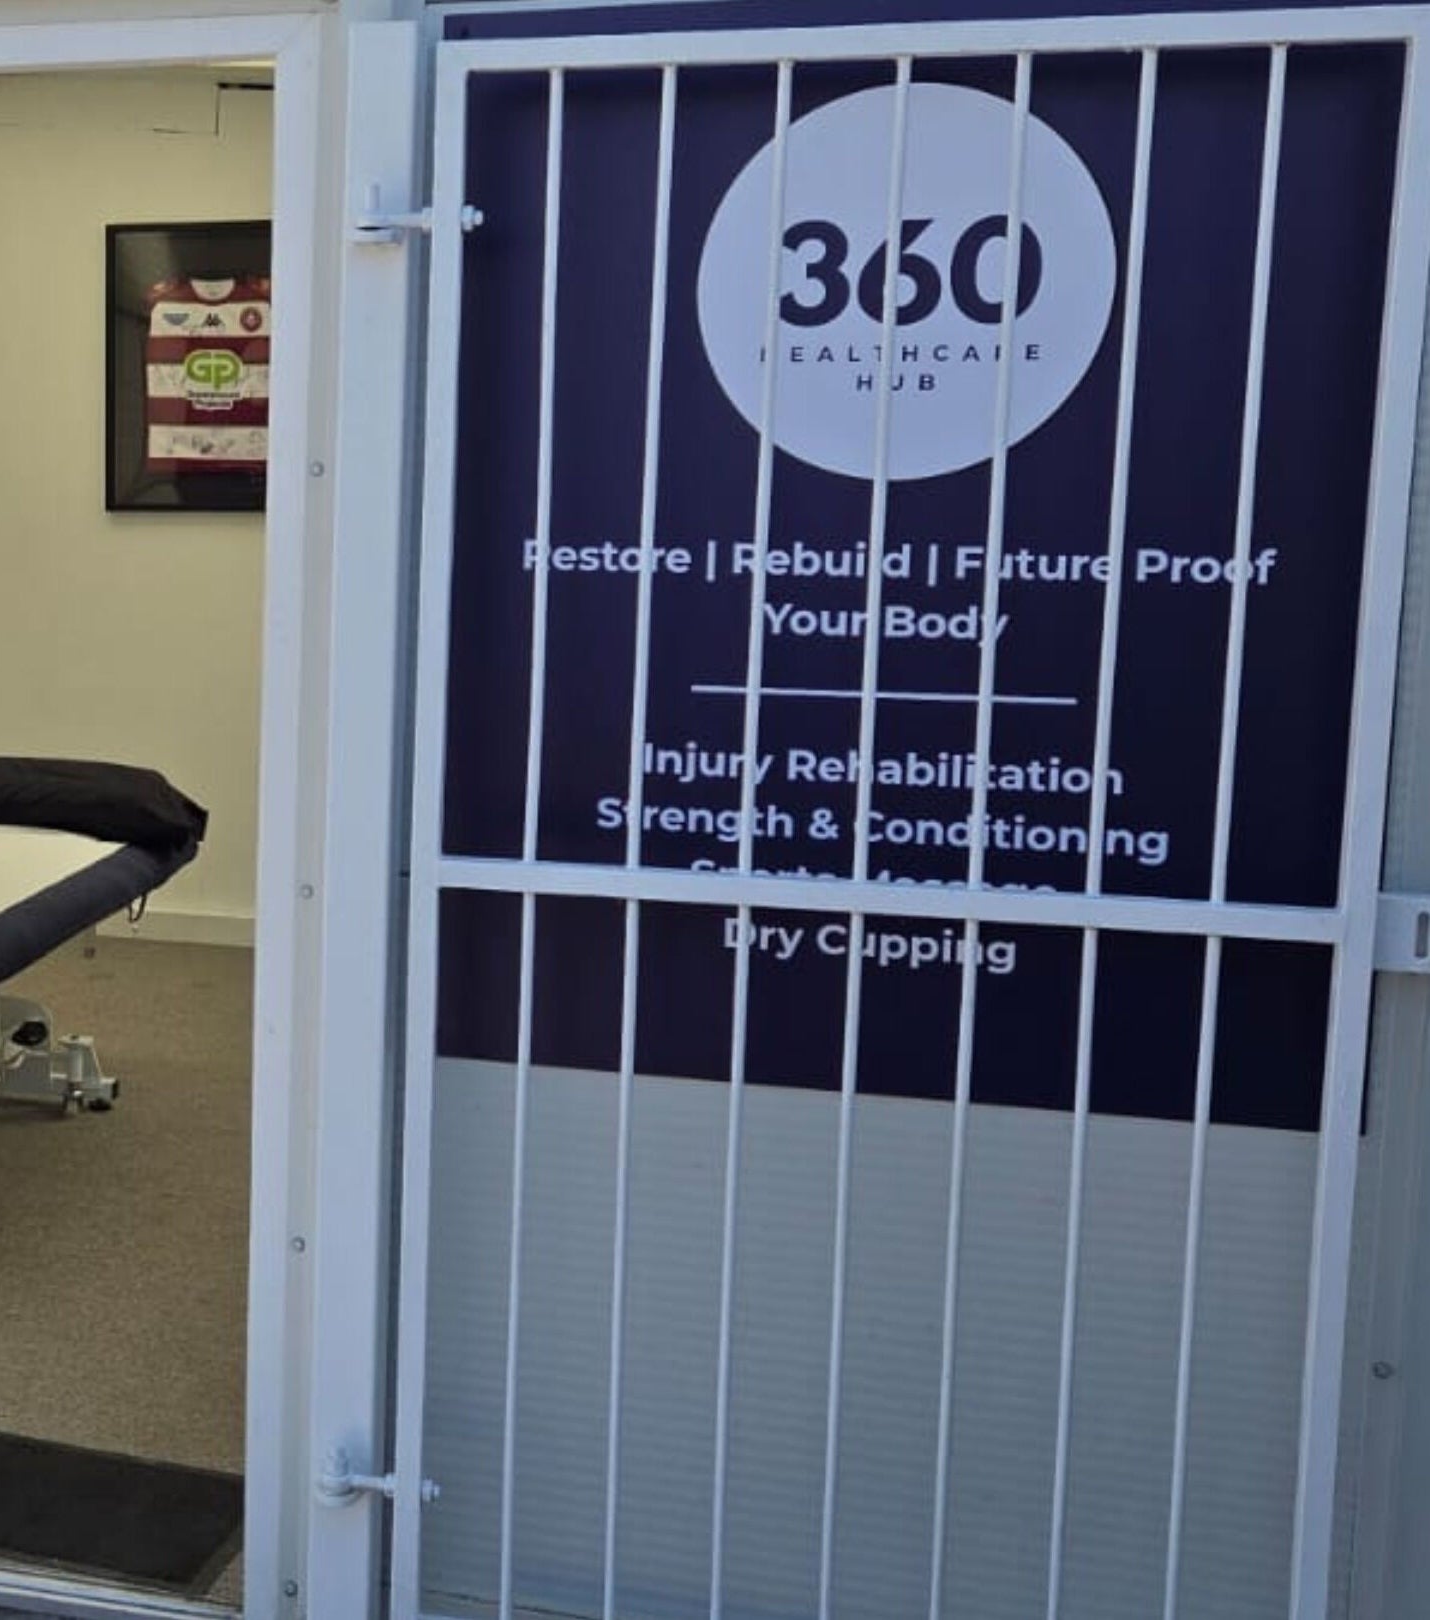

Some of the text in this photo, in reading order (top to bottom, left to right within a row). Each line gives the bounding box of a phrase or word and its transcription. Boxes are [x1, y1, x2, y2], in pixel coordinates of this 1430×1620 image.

[778, 213, 1043, 328] 360
[856, 373, 936, 391] HUB
[732, 541, 911, 578] Rebuid
[1135, 548, 1278, 585] Proof
[763, 603, 870, 636] Your
[596, 798, 1169, 866] Srength & Conditionng
[724, 917, 804, 960] Dry
